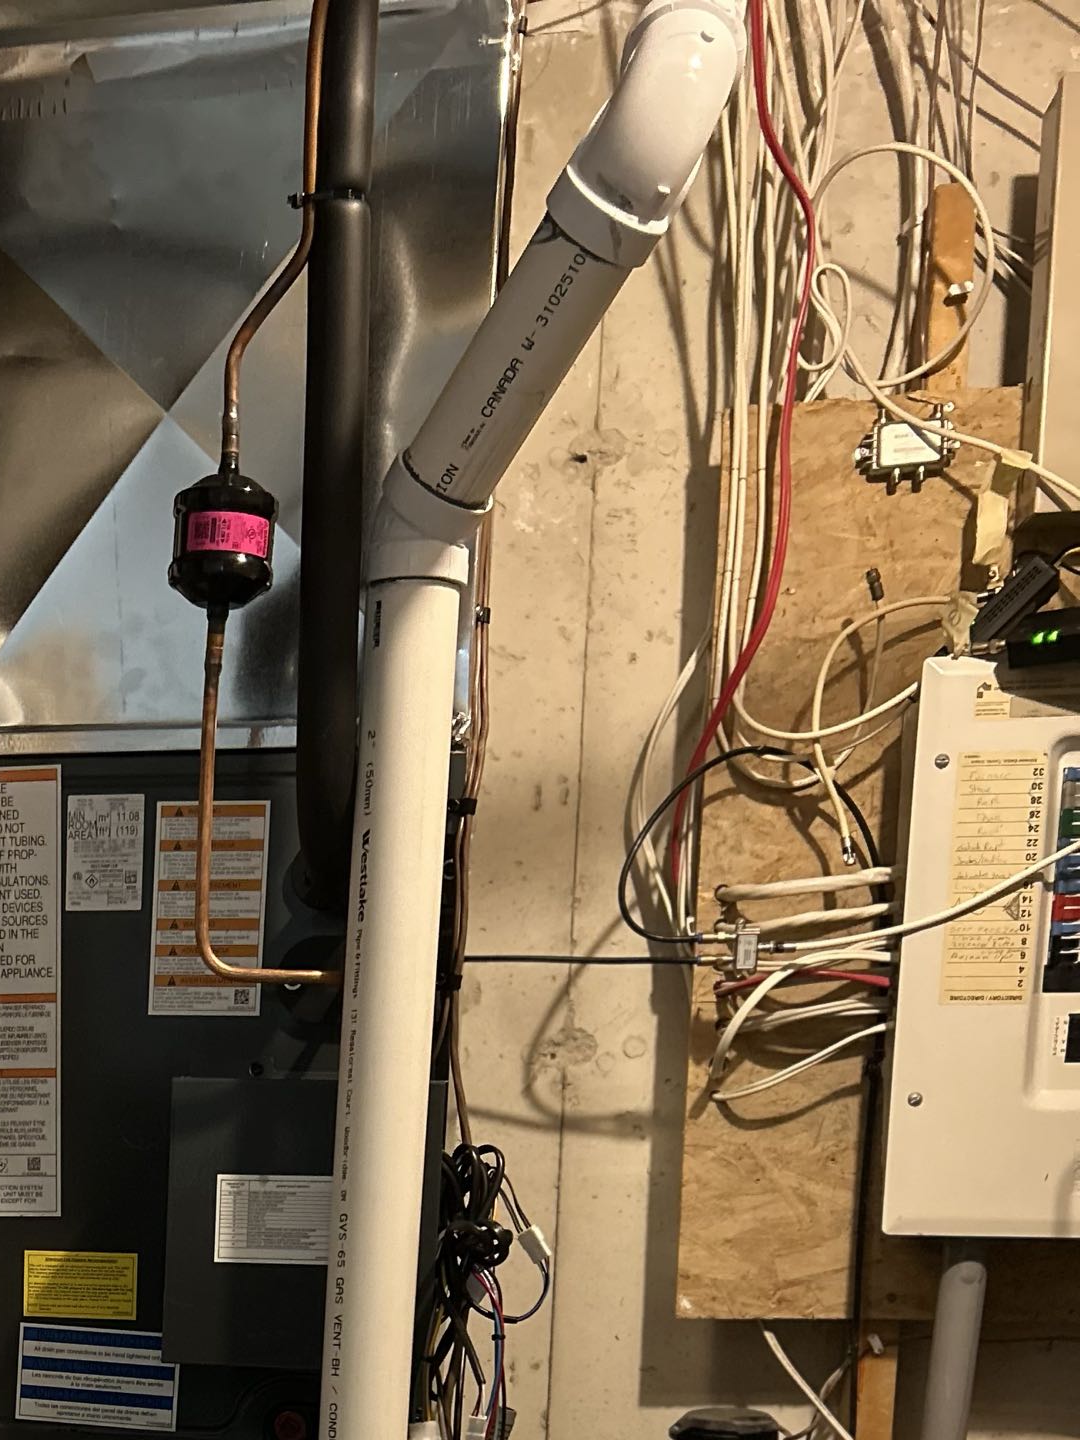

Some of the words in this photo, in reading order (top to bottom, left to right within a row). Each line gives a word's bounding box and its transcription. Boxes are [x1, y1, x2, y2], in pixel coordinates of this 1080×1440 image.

[481, 358, 524, 419] CANADA
[1032, 767, 1045, 776] 32
[364, 762, 375, 816] (50mm)
[1031, 782, 1044, 790] 30
[1, 796, 14, 807] BE
[5, 822, 25, 834] NOT
[68, 821, 97, 830] ROOM
[68, 831, 93, 840] AREA
[116, 826, 139, 837] (119)
[1026, 838, 1039, 847] 22
[1025, 853, 1038, 861] 20
[358, 829, 371, 923] Westlake
[2, 902, 43, 914] DEVICES
[1020, 909, 1032, 917] 12
[1, 915, 48, 926] SOURCES
[1019, 923, 1031, 932] 10
[8, 929, 18, 939] IN
[20, 928, 39, 939] THE
[15, 954, 36, 965] FOR
[1017, 979, 1024, 988] 2
[337, 1213, 348, 1268] GVS-65
[334, 1277, 345, 1304] GAS
